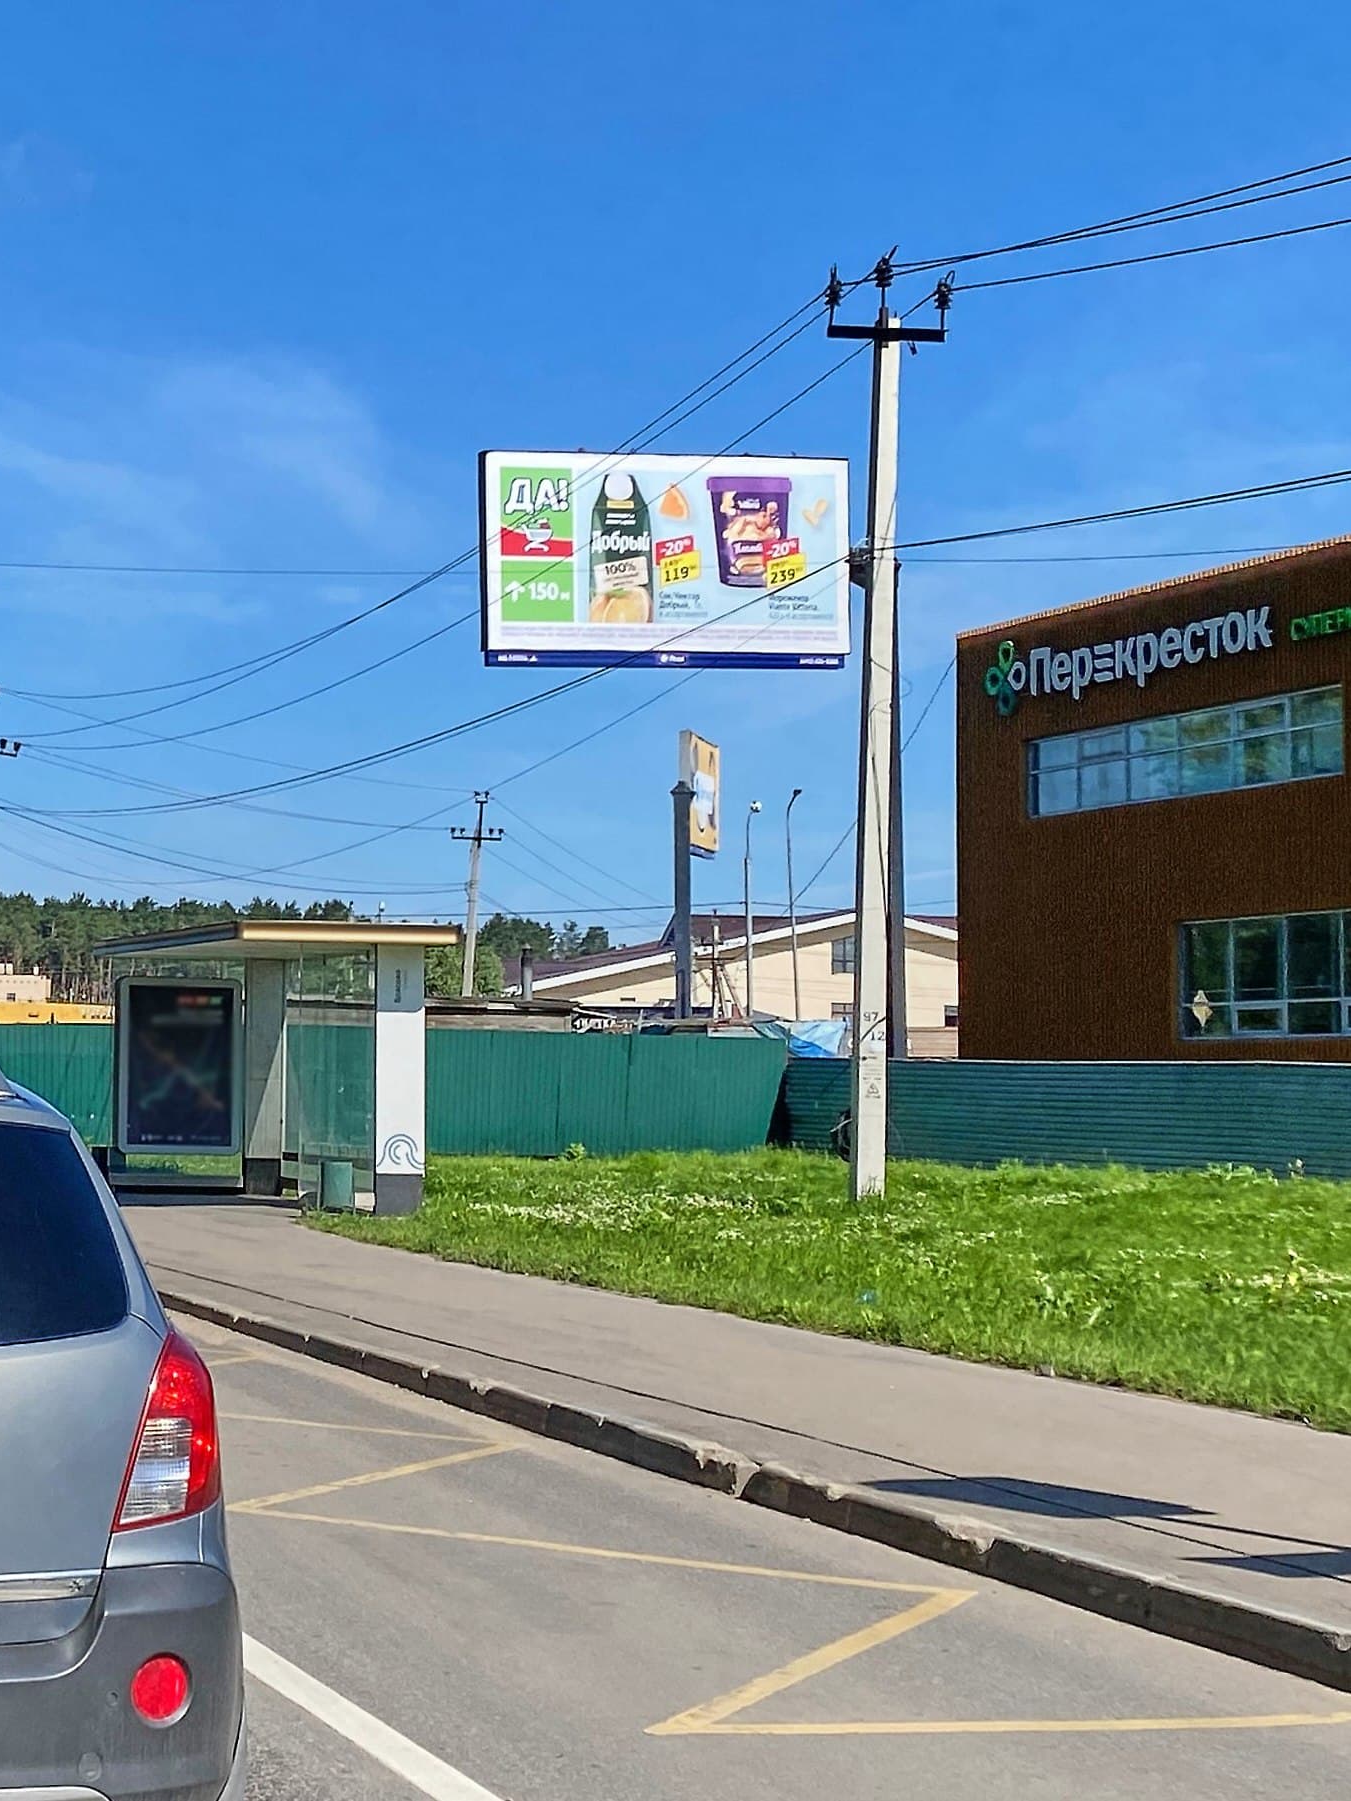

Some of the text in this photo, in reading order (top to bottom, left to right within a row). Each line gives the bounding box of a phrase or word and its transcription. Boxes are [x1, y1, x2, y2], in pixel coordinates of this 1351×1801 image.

[504, 477, 570, 515] ДА!
[592, 530, 650, 554] Добрый
[770, 567, 796, 585] 239
[529, 581, 559, 600] 150
